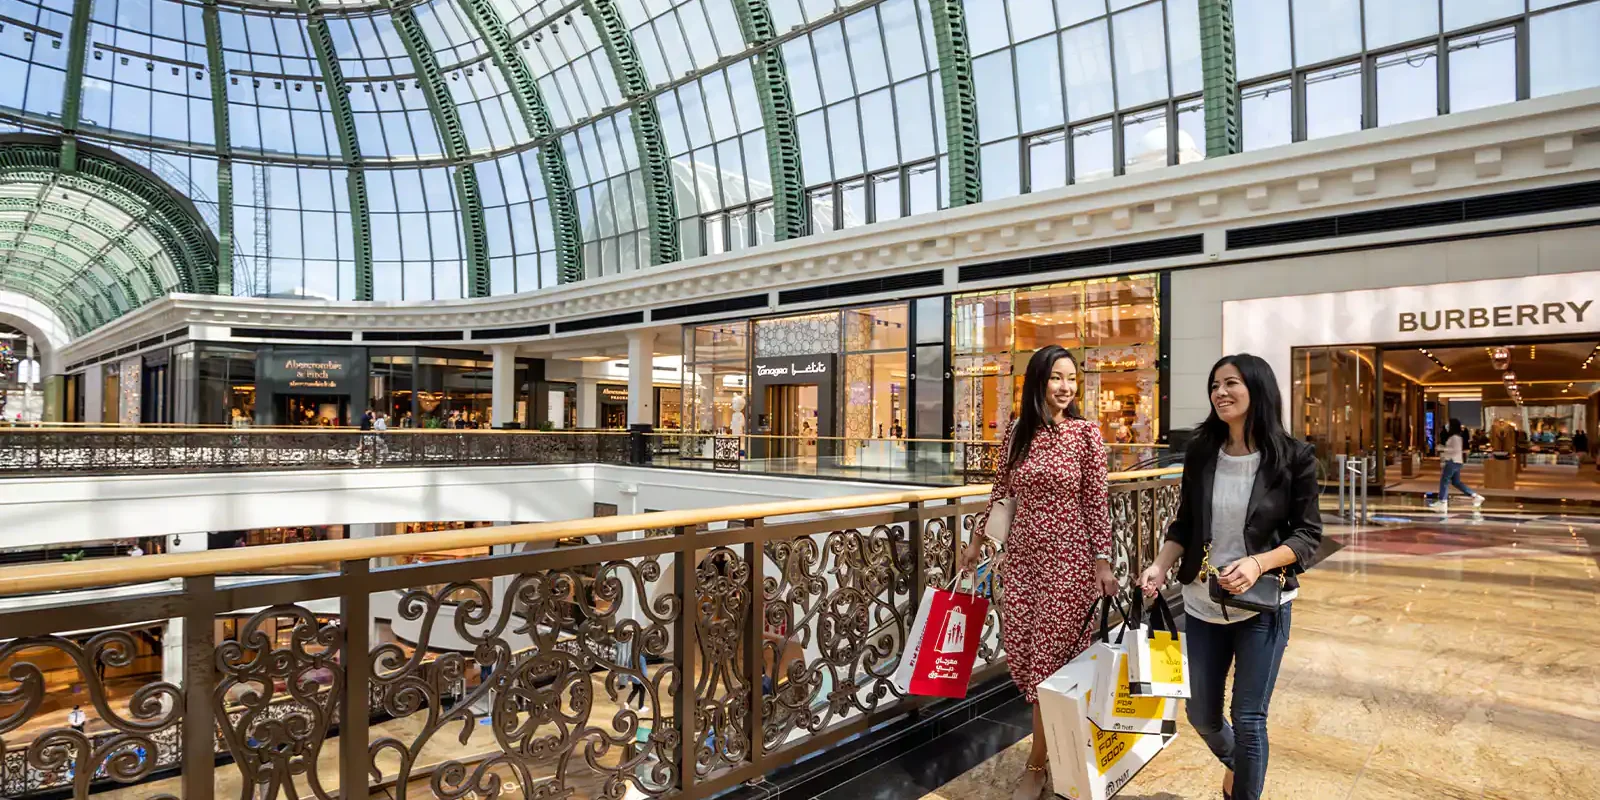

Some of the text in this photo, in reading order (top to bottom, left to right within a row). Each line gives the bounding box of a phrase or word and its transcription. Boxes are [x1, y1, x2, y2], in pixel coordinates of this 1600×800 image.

[1398, 300, 1593, 332] BURBERRY
[285, 360, 342, 370] Abercrombie
[756, 364, 788, 376] Tanagra
[935, 657, 958, 665] مهرجان
[935, 664, 954, 672] دبي
[928, 670, 958, 679] للتسوق
[1099, 732, 1118, 754] FOR
[1101, 742, 1125, 767] GOOD
[1115, 769, 1130, 787] THAT
